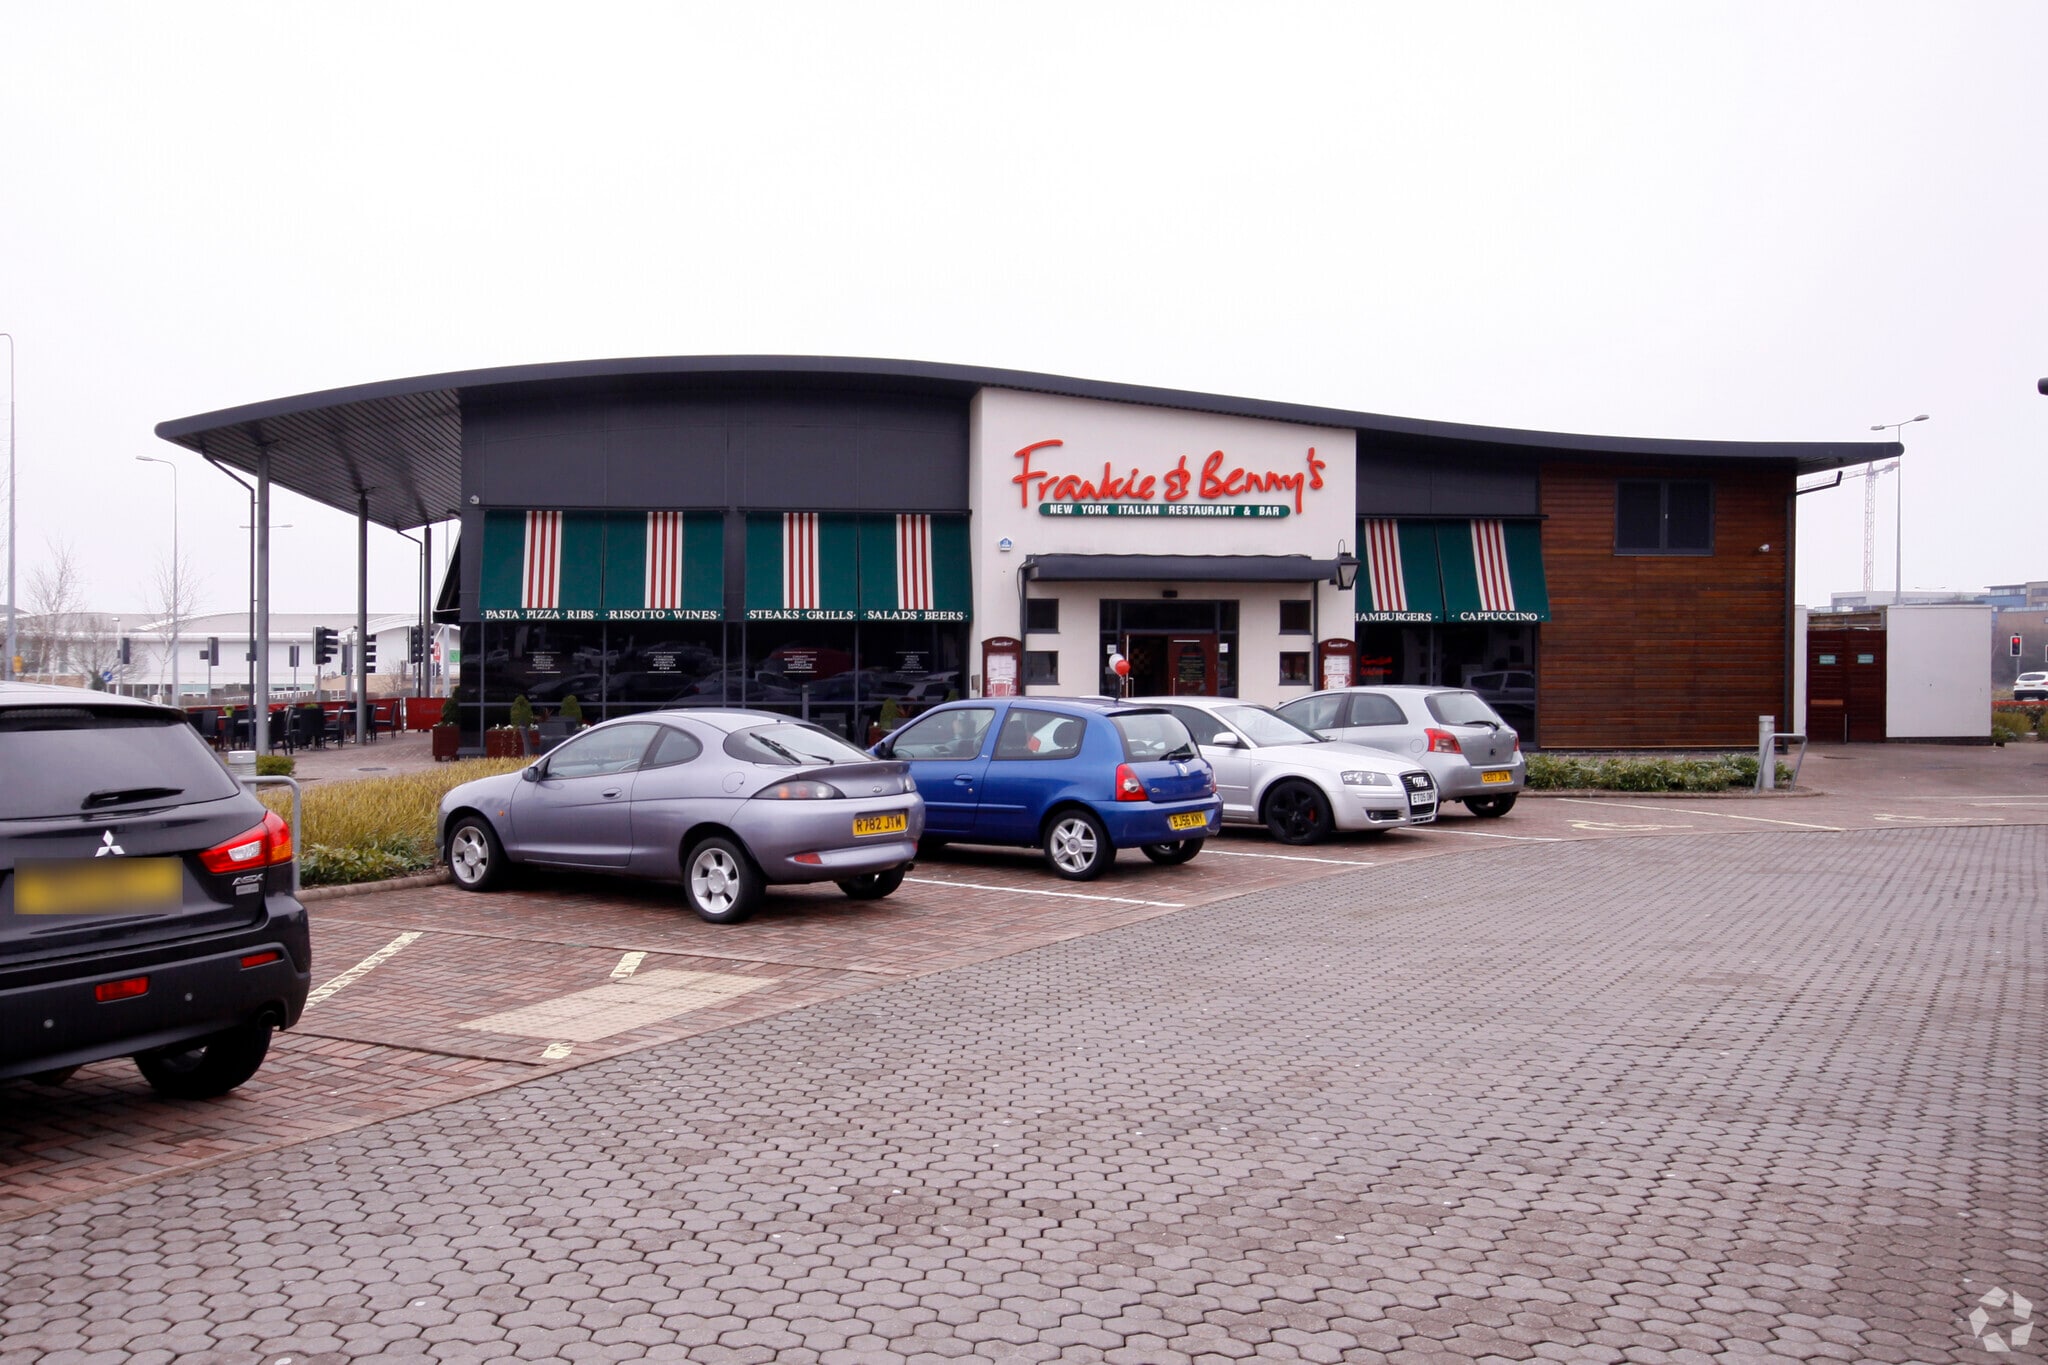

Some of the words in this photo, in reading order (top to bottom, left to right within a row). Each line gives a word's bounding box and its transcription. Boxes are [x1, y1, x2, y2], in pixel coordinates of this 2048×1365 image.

[1012, 439, 1156, 508] Frankie
[1164, 455, 1191, 501] &
[1199, 447, 1326, 514] Benny's
[1050, 504, 1073, 514] NEW
[1081, 504, 1109, 515] YORK
[1118, 504, 1159, 515] ITALIAN
[1168, 505, 1236, 516] RESTAURANT
[1243, 506, 1251, 516] &
[1258, 506, 1280, 516] BAR
[485, 609, 520, 619] PASTA
[526, 609, 560, 619] PIZZA
[567, 609, 594, 619] RIBS
[609, 609, 666, 619] RISOTTO
[673, 609, 718, 620] WINES
[749, 609, 800, 620] STEAKS
[806, 609, 854, 620] GRILLS
[867, 610, 918, 620] SALADS
[924, 610, 964, 621] BEERS
[1460, 611, 1538, 622] CAPPUCCINO
[856, 817, 882, 832] R782
